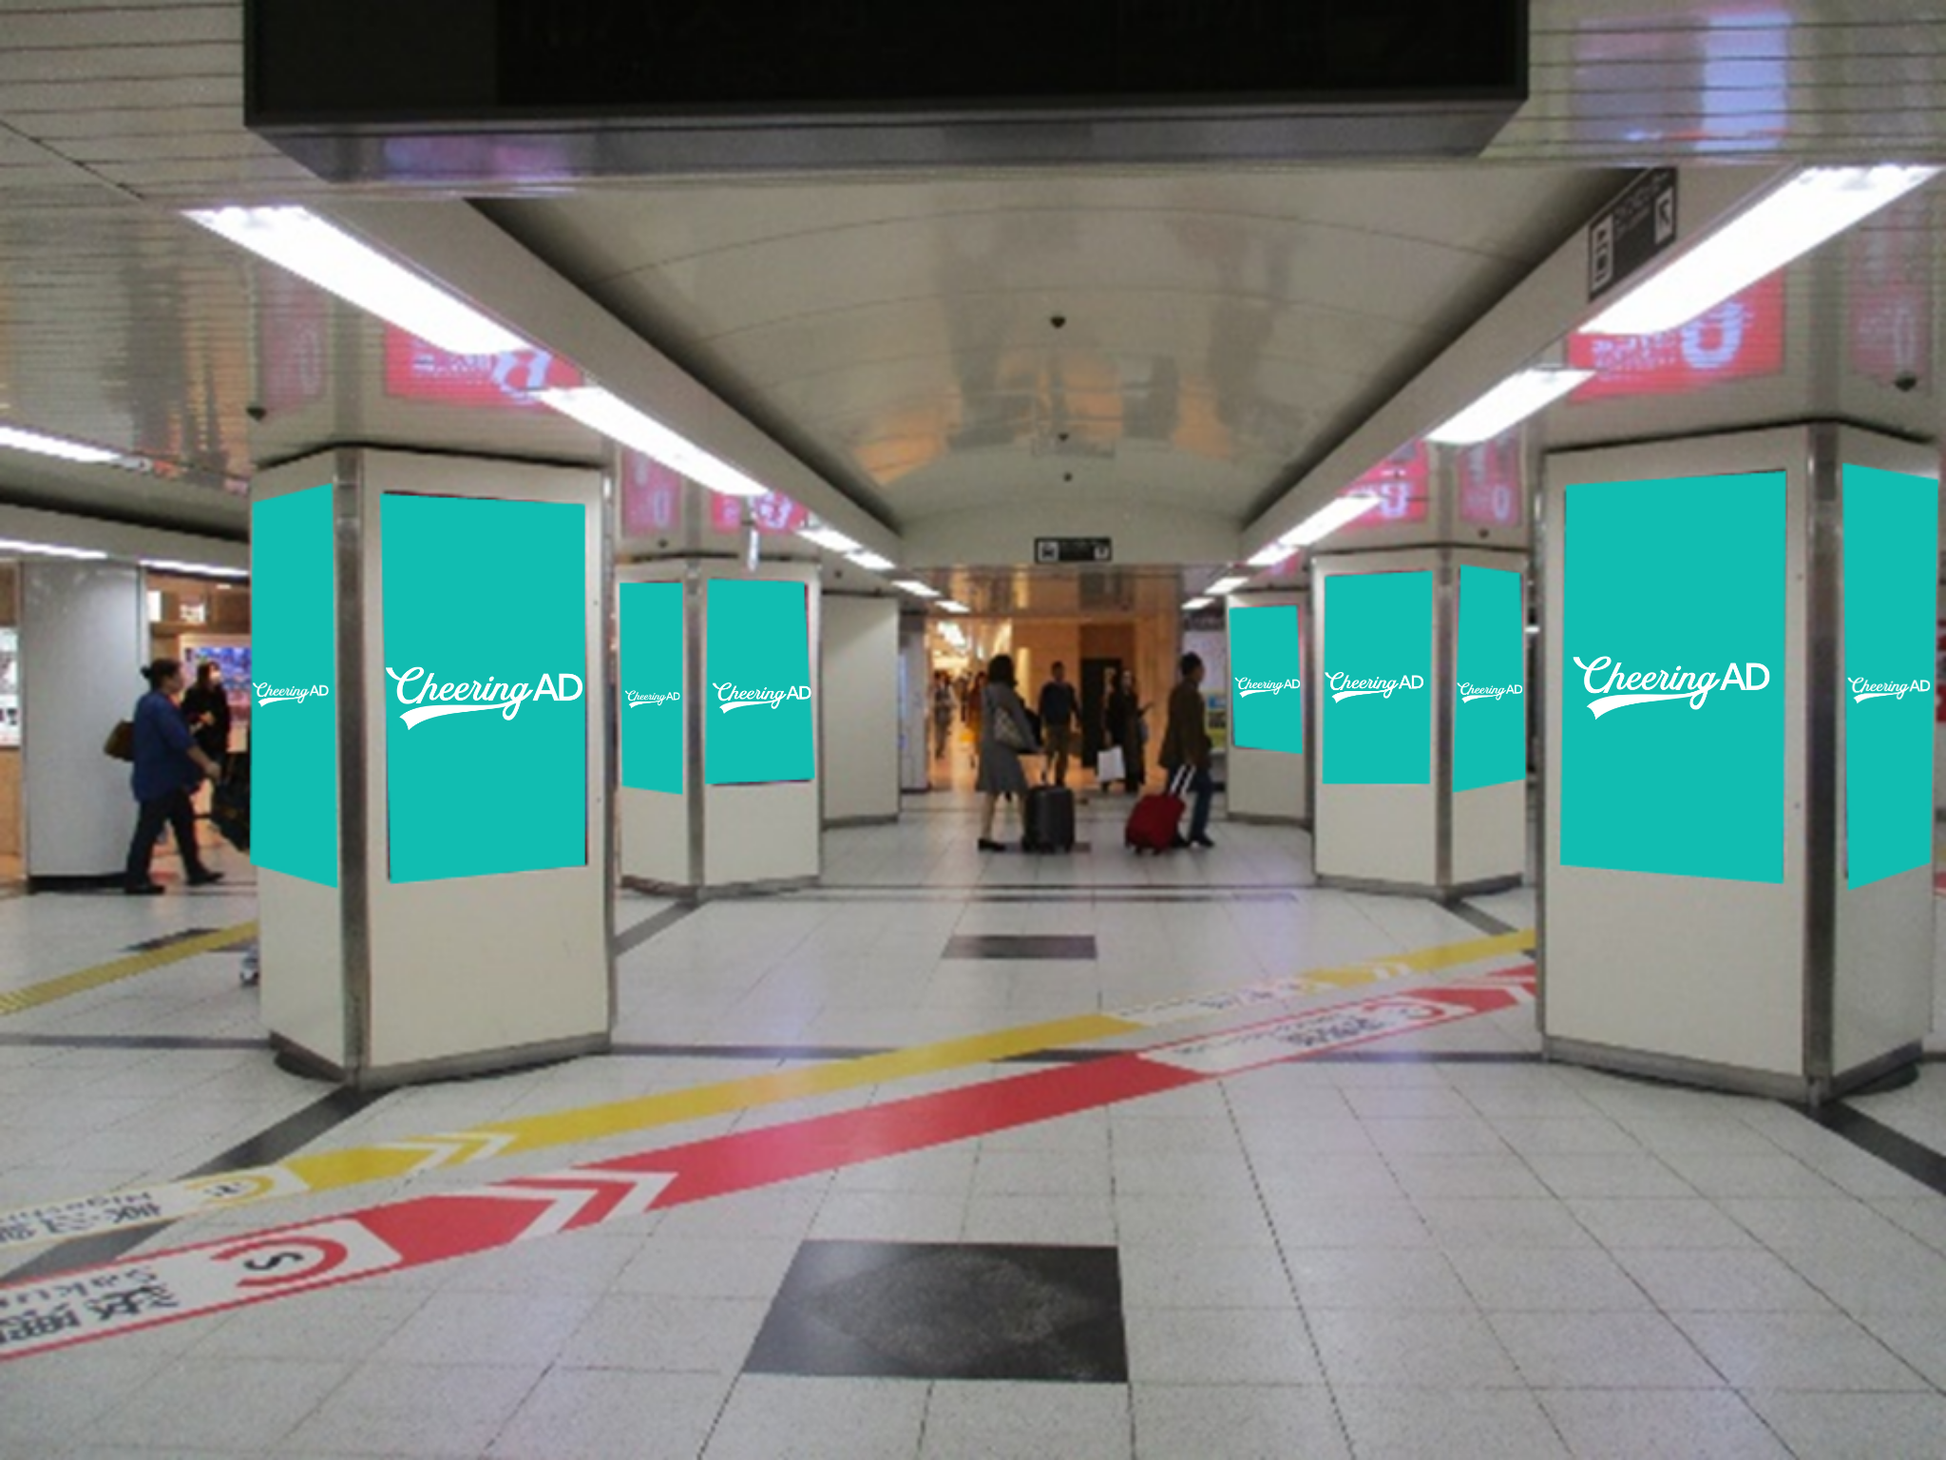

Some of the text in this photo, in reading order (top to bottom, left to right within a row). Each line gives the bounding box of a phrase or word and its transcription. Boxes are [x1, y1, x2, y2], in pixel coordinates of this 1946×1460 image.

[252, 681, 330, 707] Cheering AD
[385, 666, 584, 729] Cheering AD
[624, 689, 681, 708] Cheering AD
[712, 682, 812, 714] Cheering AD
[1234, 676, 1301, 698] Cheering AD
[1324, 671, 1424, 703] Cheering AD
[1456, 681, 1523, 703] Cheering AD
[1572, 655, 1771, 719] Cheering AD
[1847, 676, 1931, 703] Cheering AD
